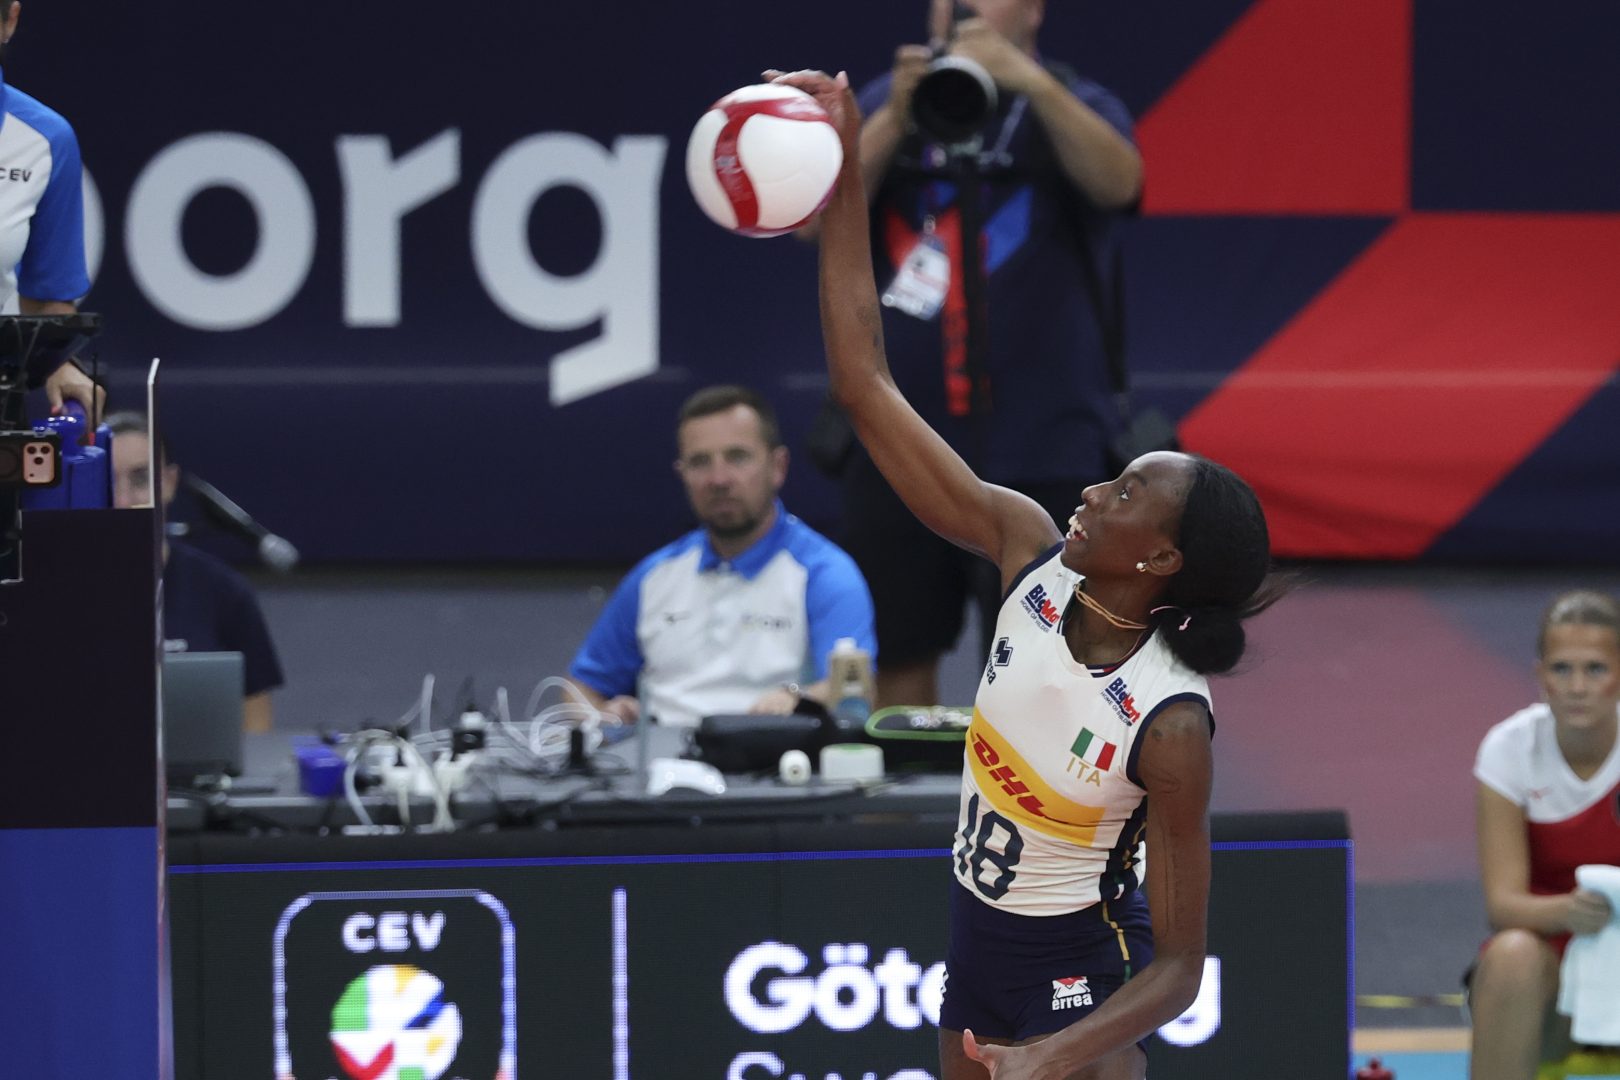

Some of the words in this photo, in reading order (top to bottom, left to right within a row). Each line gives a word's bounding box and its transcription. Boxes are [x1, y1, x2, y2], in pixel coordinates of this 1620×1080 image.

[82, 128, 668, 406] org
[973, 735, 1048, 819] DHL
[1066, 756, 1101, 787] ITA
[957, 792, 1025, 901] 18
[341, 911, 447, 954] CEV
[1051, 993, 1093, 1011] errea
